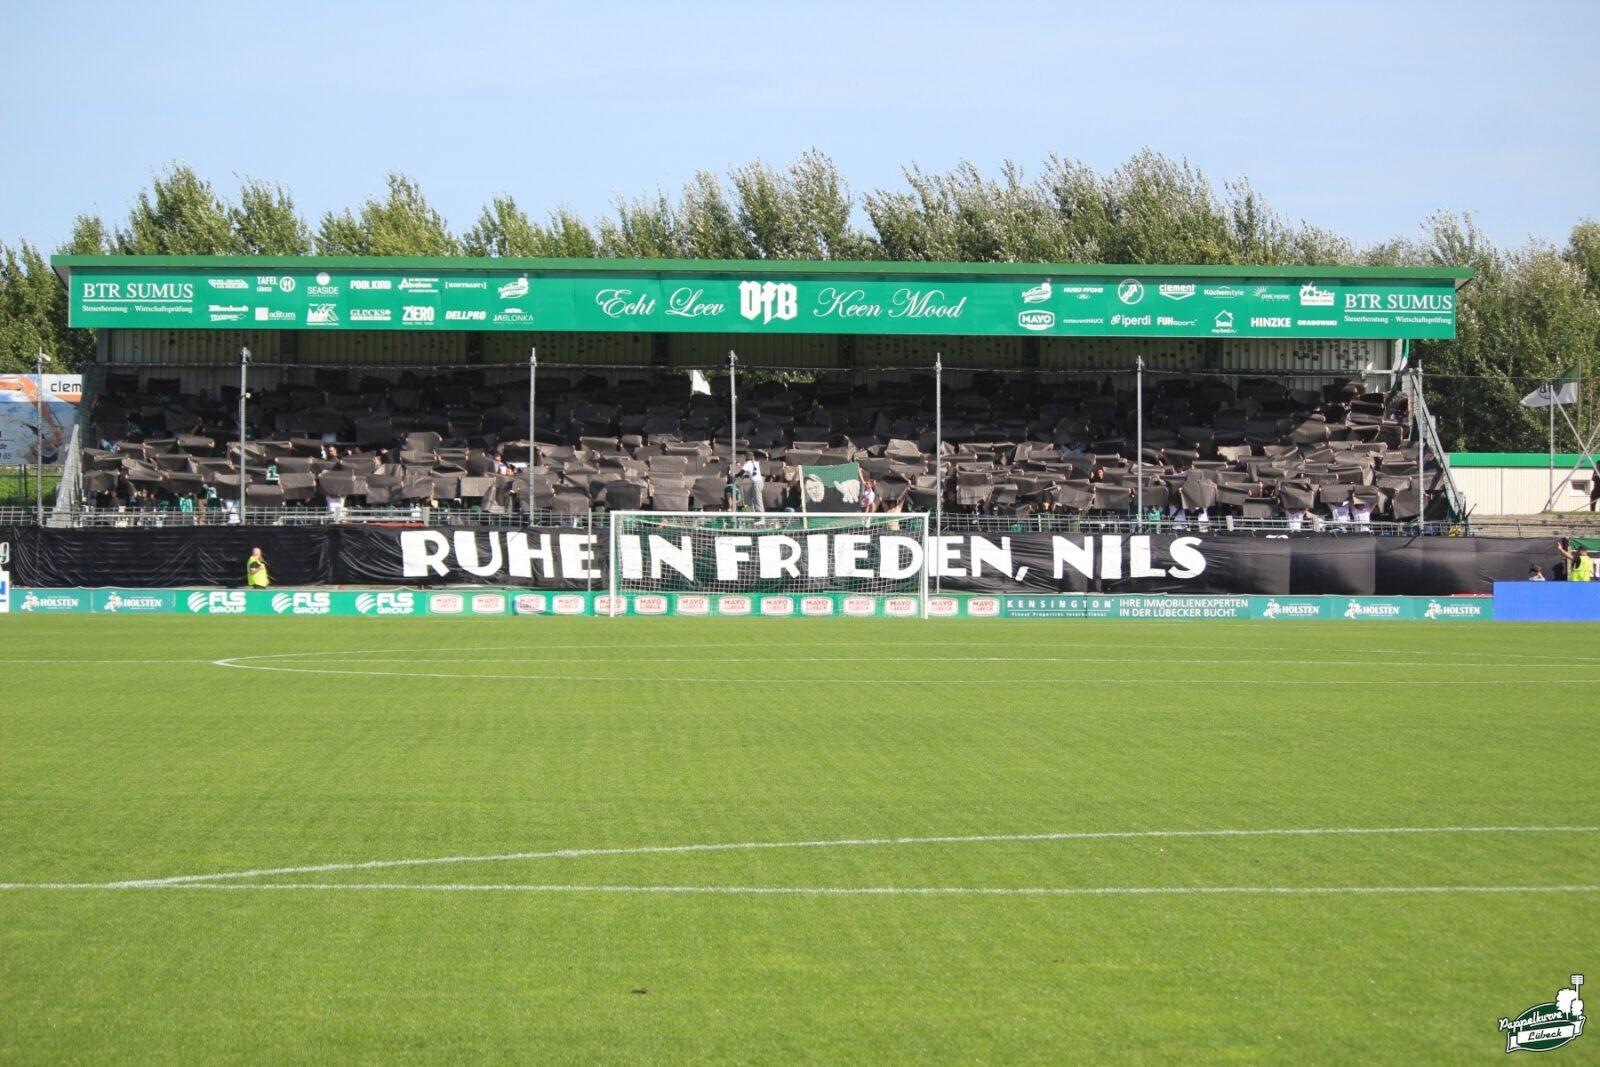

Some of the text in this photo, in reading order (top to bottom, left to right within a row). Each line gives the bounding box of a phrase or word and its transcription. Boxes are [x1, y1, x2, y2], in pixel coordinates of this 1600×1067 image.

[257, 276, 277, 285] TAFEL
[83, 283, 121, 298] BTR
[127, 283, 193, 298] SUMUS
[596, 287, 726, 318] Echt Leev
[813, 288, 967, 318] Keen Mood
[1345, 294, 1382, 309] BTR
[1387, 294, 1452, 310] SUMUS
[1122, 315, 1151, 327] iperdi
[1251, 317, 1291, 327] HINZKE
[400, 530, 1206, 581] RUHE IN FRIEDEN, NILS
[40, 599, 78, 607] HOLSTEN
[124, 599, 161, 607] HOLSTEN
[208, 592, 246, 606] FLS
[293, 593, 330, 607] FLS
[377, 593, 414, 608] FLS
[1144, 599, 1248, 607] IMMOBILIENEXPERTEN
[1154, 608, 1201, 616] LÜBECKER
